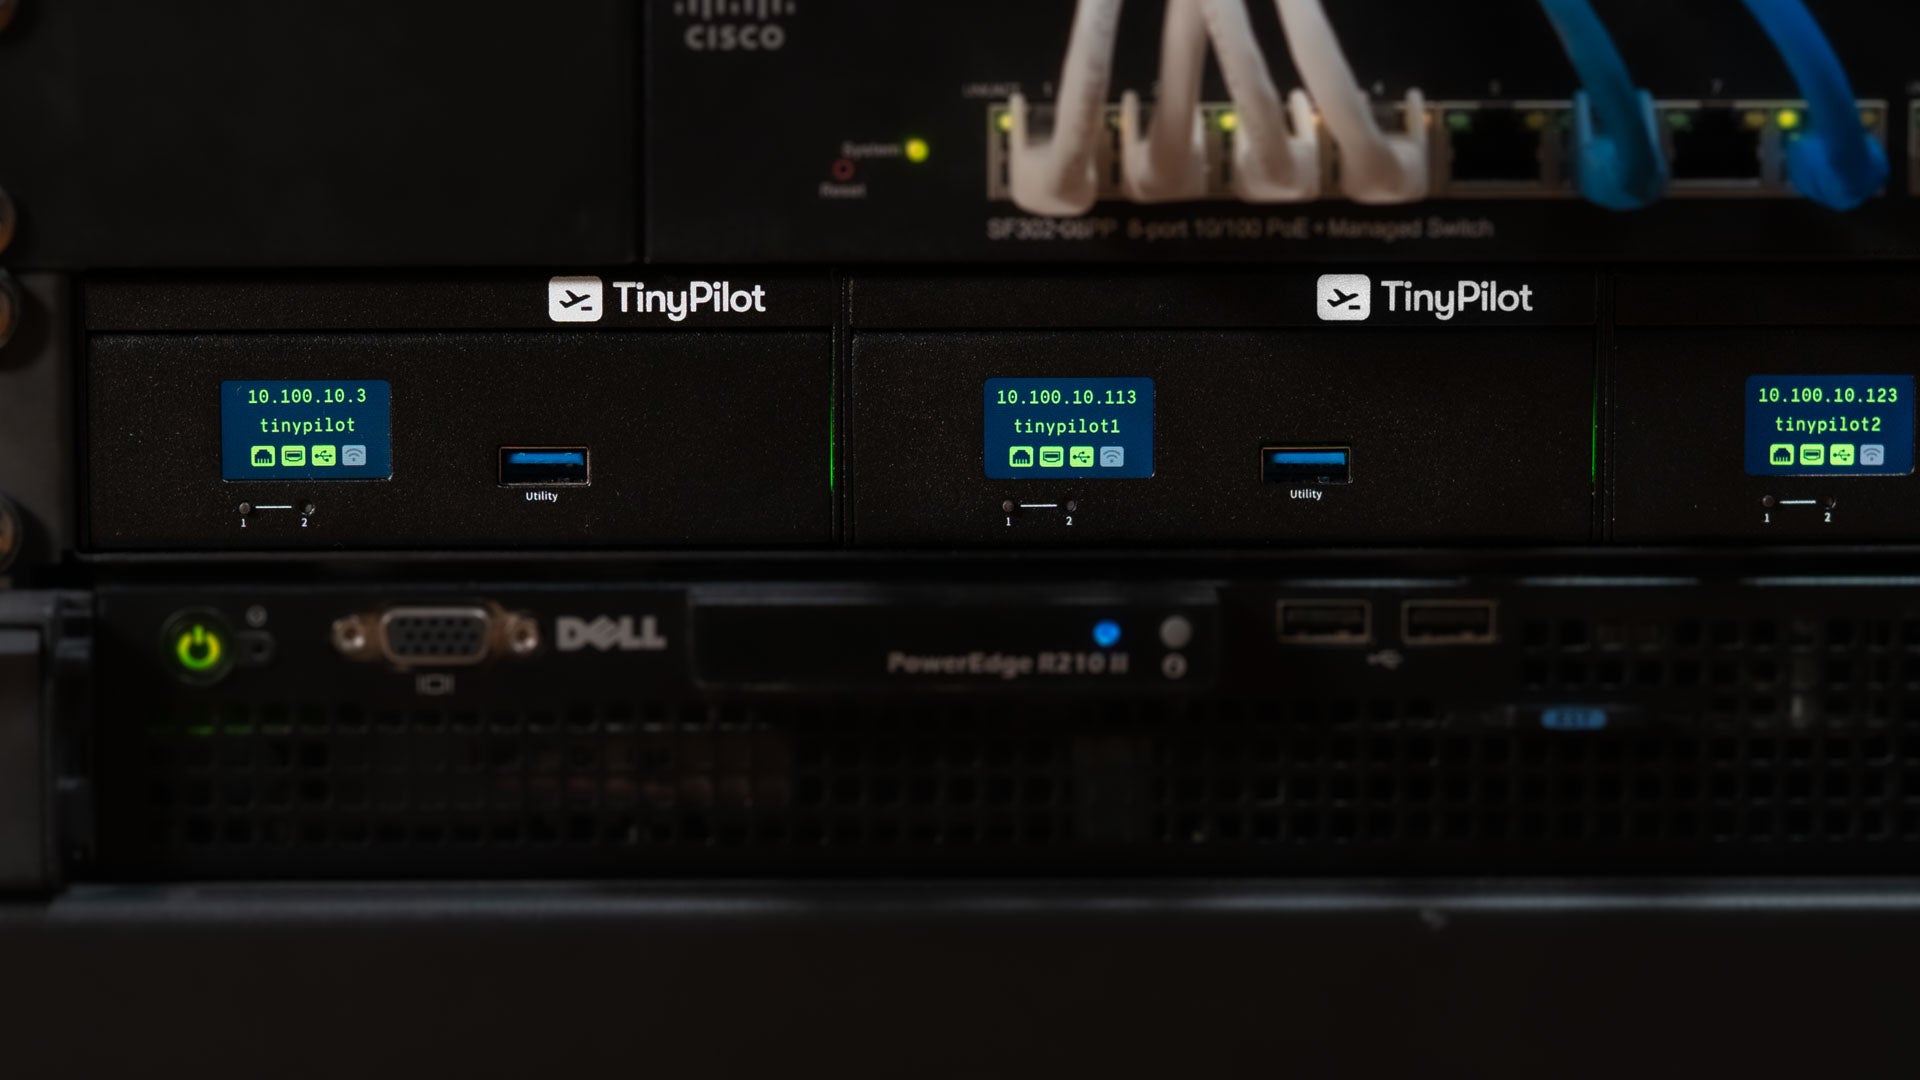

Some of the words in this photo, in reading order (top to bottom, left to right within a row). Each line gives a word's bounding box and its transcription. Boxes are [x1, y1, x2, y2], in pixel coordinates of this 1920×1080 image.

[684, 24, 786, 51] CISCO
[1195, 217, 1262, 240] 10/100
[1328, 216, 1423, 244] Managed
[1426, 215, 1495, 240] Switch
[612, 280, 767, 322] TinyPilot
[1380, 279, 1534, 321] TinyPilot
[247, 387, 367, 404] 10.100.10.3
[996, 389, 1137, 405] 10.100.10.113
[1758, 387, 1899, 403] 10.100.10.123
[259, 416, 356, 435] tinypilot
[1014, 418, 1121, 437] tinypilot1
[1775, 416, 1882, 435] tinypilot2
[525, 490, 559, 503] Utility
[1289, 488, 1323, 502] Utility
[240, 518, 247, 528] 1
[301, 517, 309, 528] 2
[1005, 516, 1012, 527] 1
[1065, 516, 1073, 527] 2
[1763, 513, 1771, 523] 1
[1823, 512, 1832, 523] 2
[556, 615, 667, 652] DELL
[887, 650, 1034, 680] PowerEdge
[1037, 651, 1106, 676] R210
